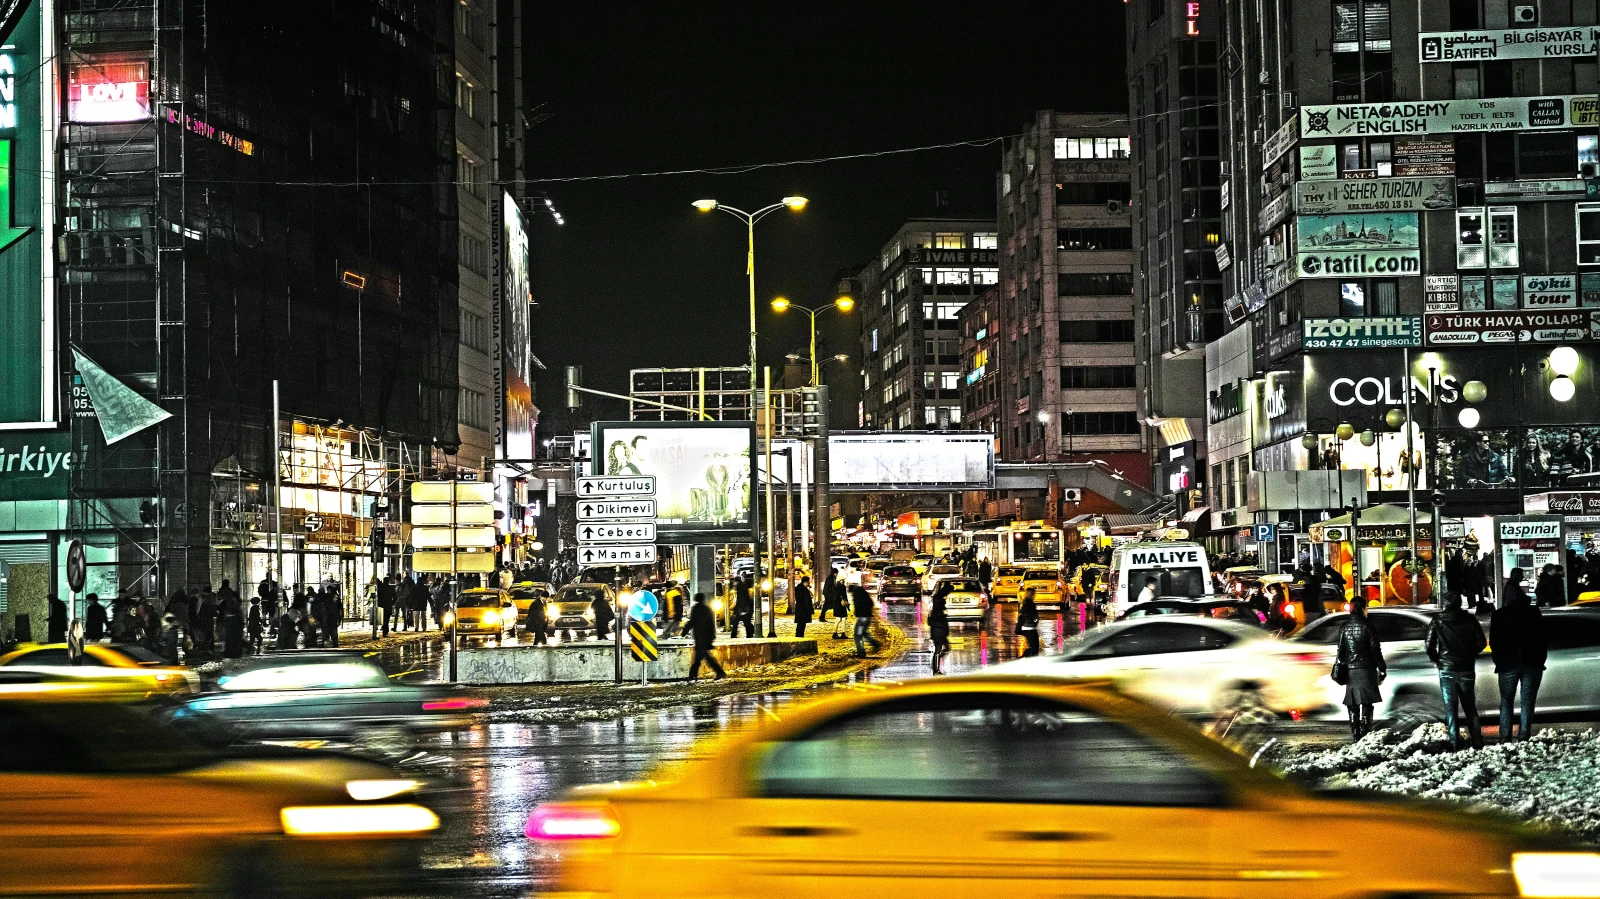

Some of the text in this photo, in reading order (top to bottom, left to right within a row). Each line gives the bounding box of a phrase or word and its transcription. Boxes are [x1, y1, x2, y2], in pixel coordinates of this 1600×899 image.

[1503, 30, 1583, 44] BİLGİSAYAR
[1444, 48, 1496, 59] BATIFEN
[1538, 100, 1554, 108] with
[1337, 103, 1450, 120] NETACADEMY
[1532, 109, 1561, 117] CALLAN
[1357, 119, 1427, 133] ENGLISH
[1451, 121, 1523, 131] HAZIRLIK ATLAMA
[1533, 117, 1560, 125] Method
[1304, 194, 1325, 202] THY
[1343, 182, 1378, 200] SEHER
[1382, 179, 1423, 198] TURİZM
[1392, 201, 1402, 209] 13
[1404, 200, 1414, 208] 51
[1324, 254, 1419, 273] tatil.com
[1528, 277, 1571, 291] öykü
[1428, 293, 1456, 302] KIBRIS
[1529, 293, 1571, 305] tour
[1446, 315, 1481, 328] TÜRK
[1485, 316, 1524, 327] HAVA
[1305, 340, 1327, 348] 430
[1329, 339, 1343, 347] 47
[1346, 338, 1360, 346] 47
[1412, 317, 1421, 345] com
[597, 480, 651, 492] Kurtuluş
[597, 503, 651, 514] Dikimevi
[597, 527, 648, 537] Cebeci
[1258, 526, 1270, 540] P
[1501, 523, 1558, 538] taşpınar
[598, 548, 651, 560] Mamak
